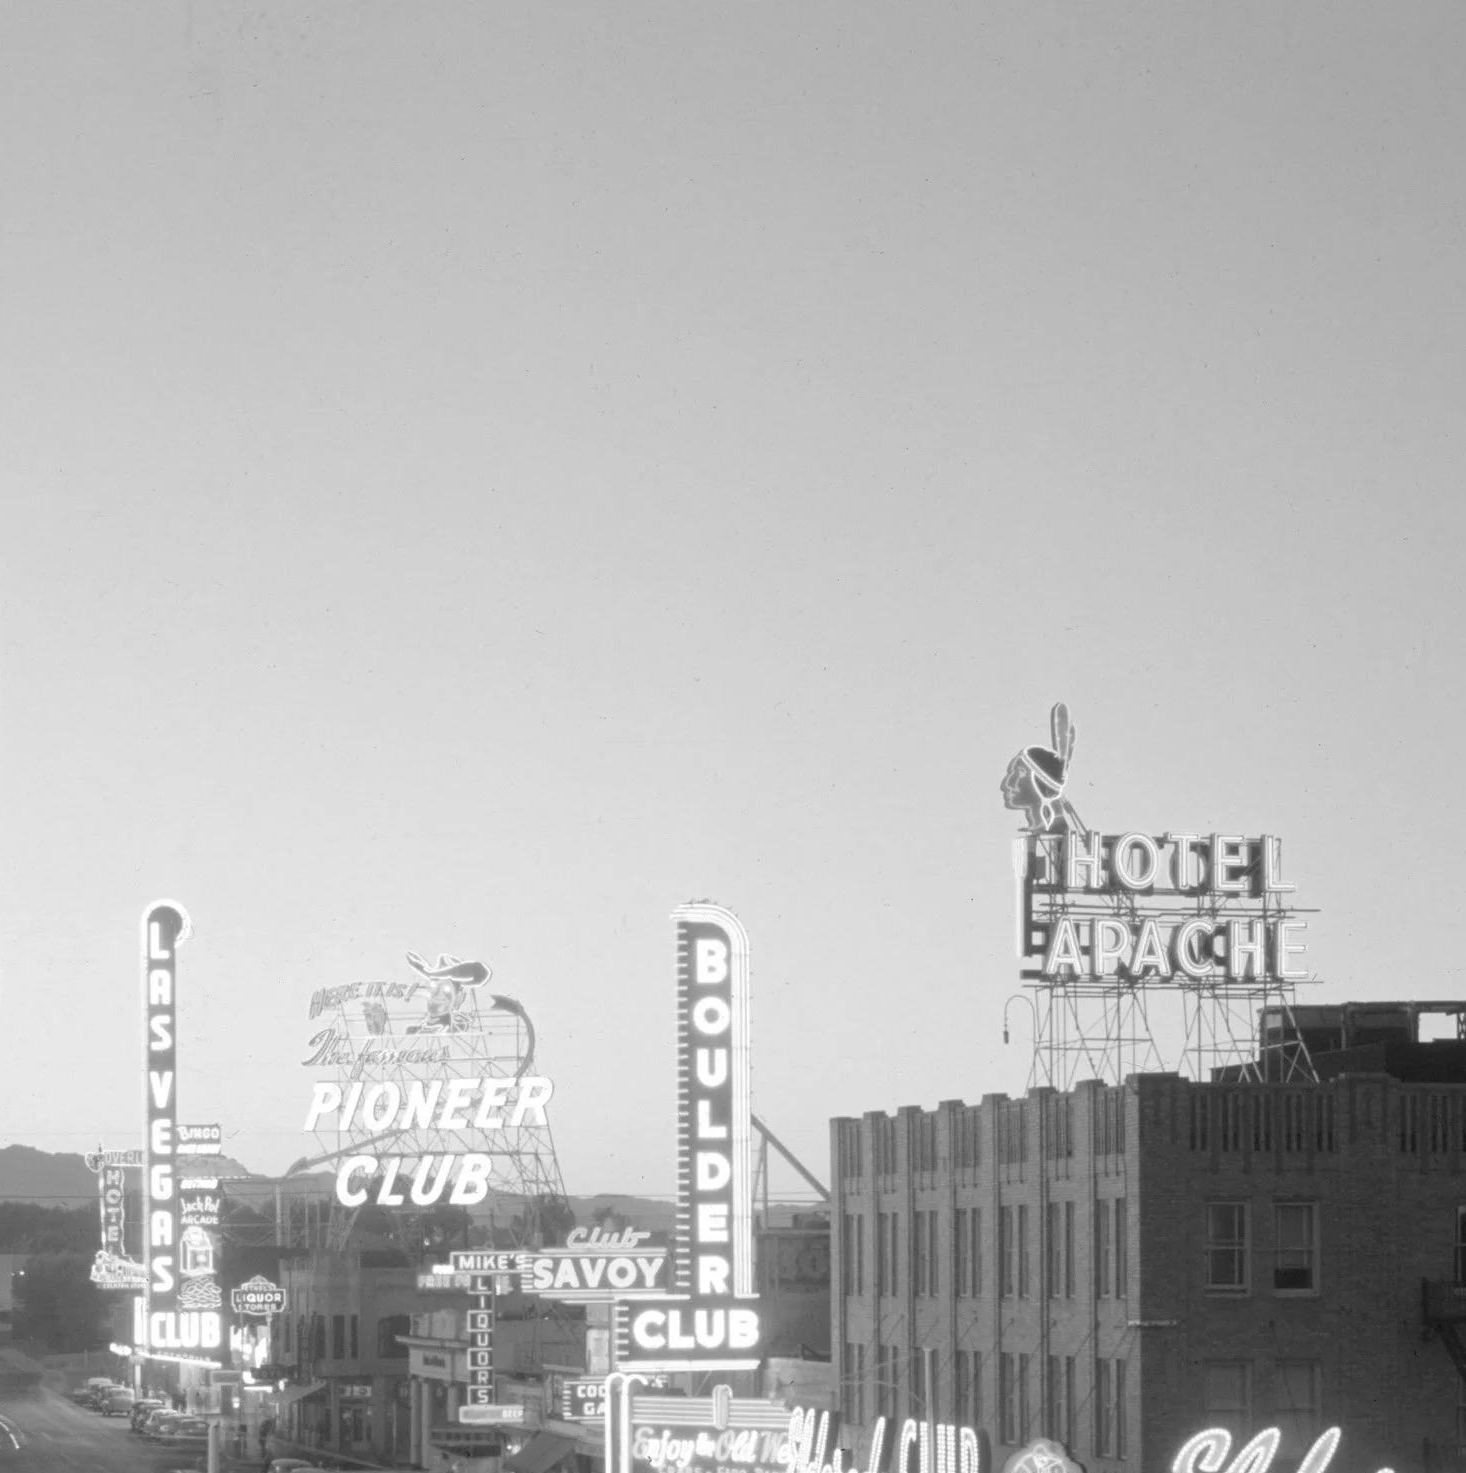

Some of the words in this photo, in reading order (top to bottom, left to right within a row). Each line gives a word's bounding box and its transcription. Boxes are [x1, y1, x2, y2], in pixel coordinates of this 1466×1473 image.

[1067, 830, 1297, 893] HOTEL
[1045, 917, 1310, 979] APACHE
[149, 921, 174, 1053] LAS
[304, 1076, 555, 1132] PIONEER
[693, 938, 730, 1295] BOULDER
[177, 1126, 220, 1141] BINGO
[149, 1071, 175, 1293] VEGAS
[336, 1153, 492, 1207] CLUB
[181, 1214, 219, 1226] ARCADE
[567, 1226, 651, 1249] Club
[459, 1254, 525, 1270] MIKE'S
[533, 1257, 664, 1289] SAVOY
[236, 1292, 282, 1304] LIQUOR
[150, 1312, 221, 1348] CLUB
[476, 1278, 489, 1405] LIQUORS
[634, 1309, 760, 1349] CLUB
[633, 1427, 695, 1468] Enjoy
[715, 1430, 758, 1463] Old
